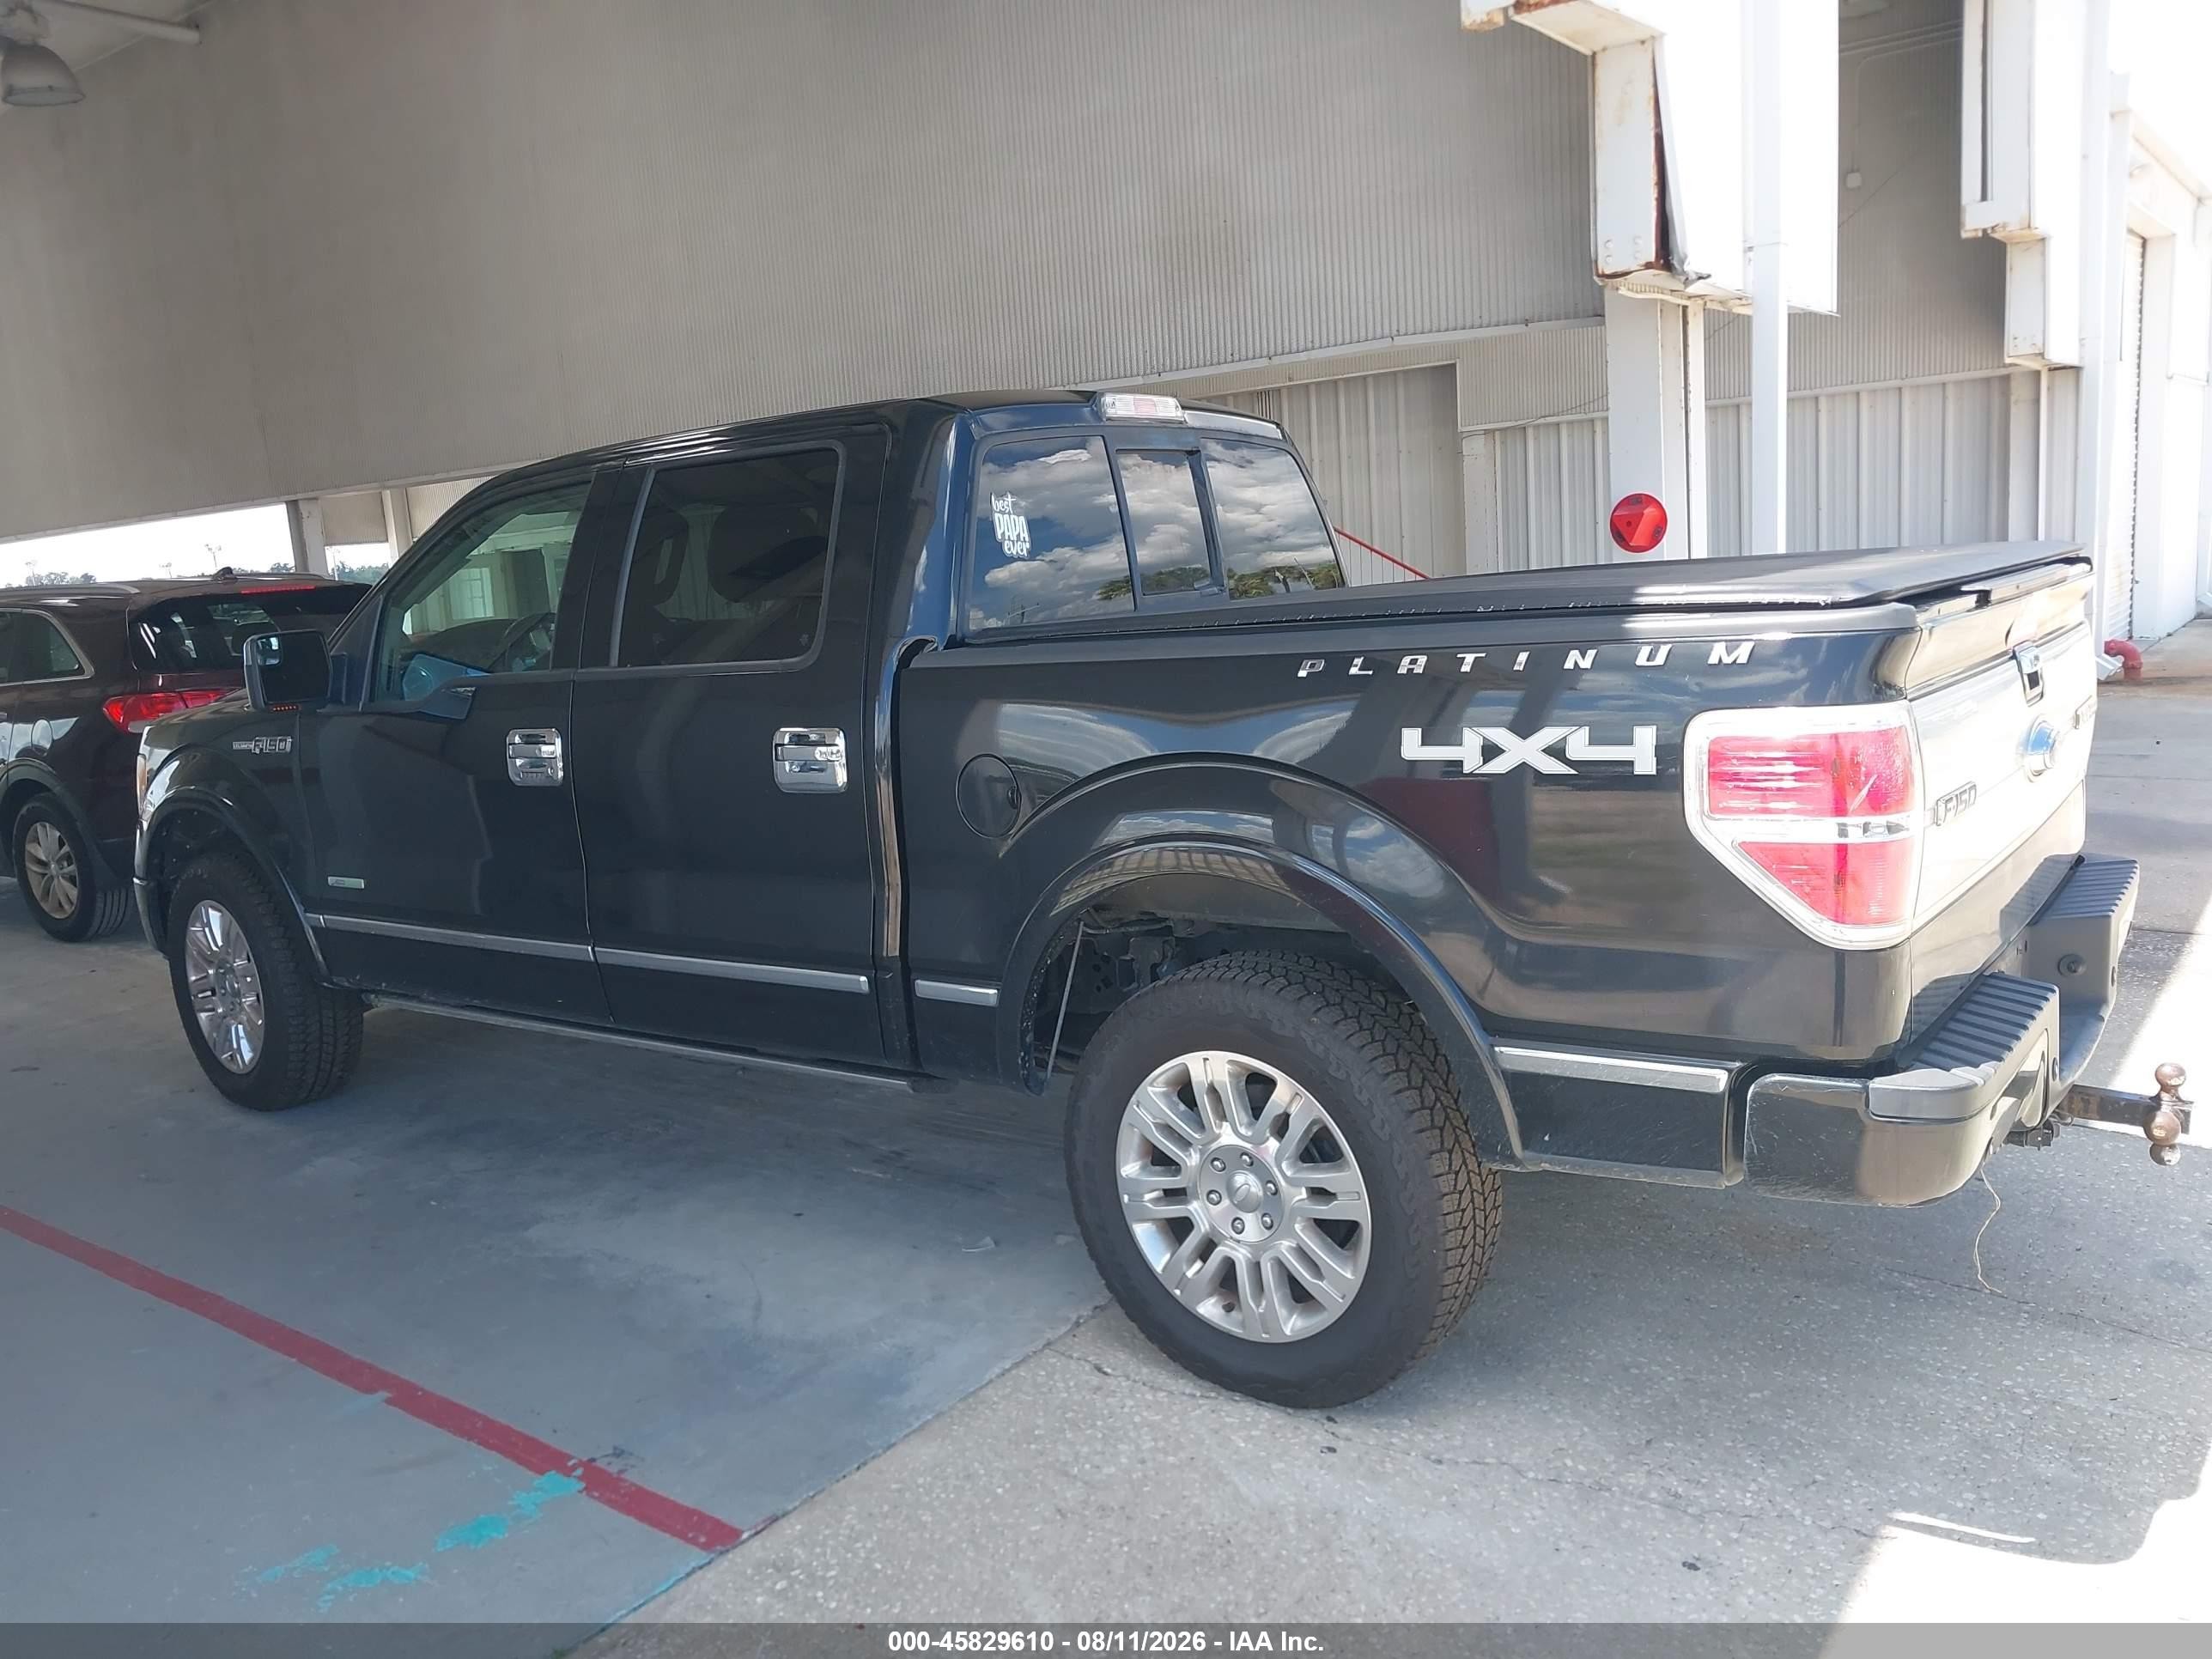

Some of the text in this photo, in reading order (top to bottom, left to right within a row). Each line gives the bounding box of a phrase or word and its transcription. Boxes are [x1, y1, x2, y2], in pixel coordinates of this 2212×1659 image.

[991, 491, 1017, 514] best
[994, 514, 1030, 541] PAPA
[1004, 540, 1030, 557] ever
[1297, 641, 1754, 678] PLATINUM
